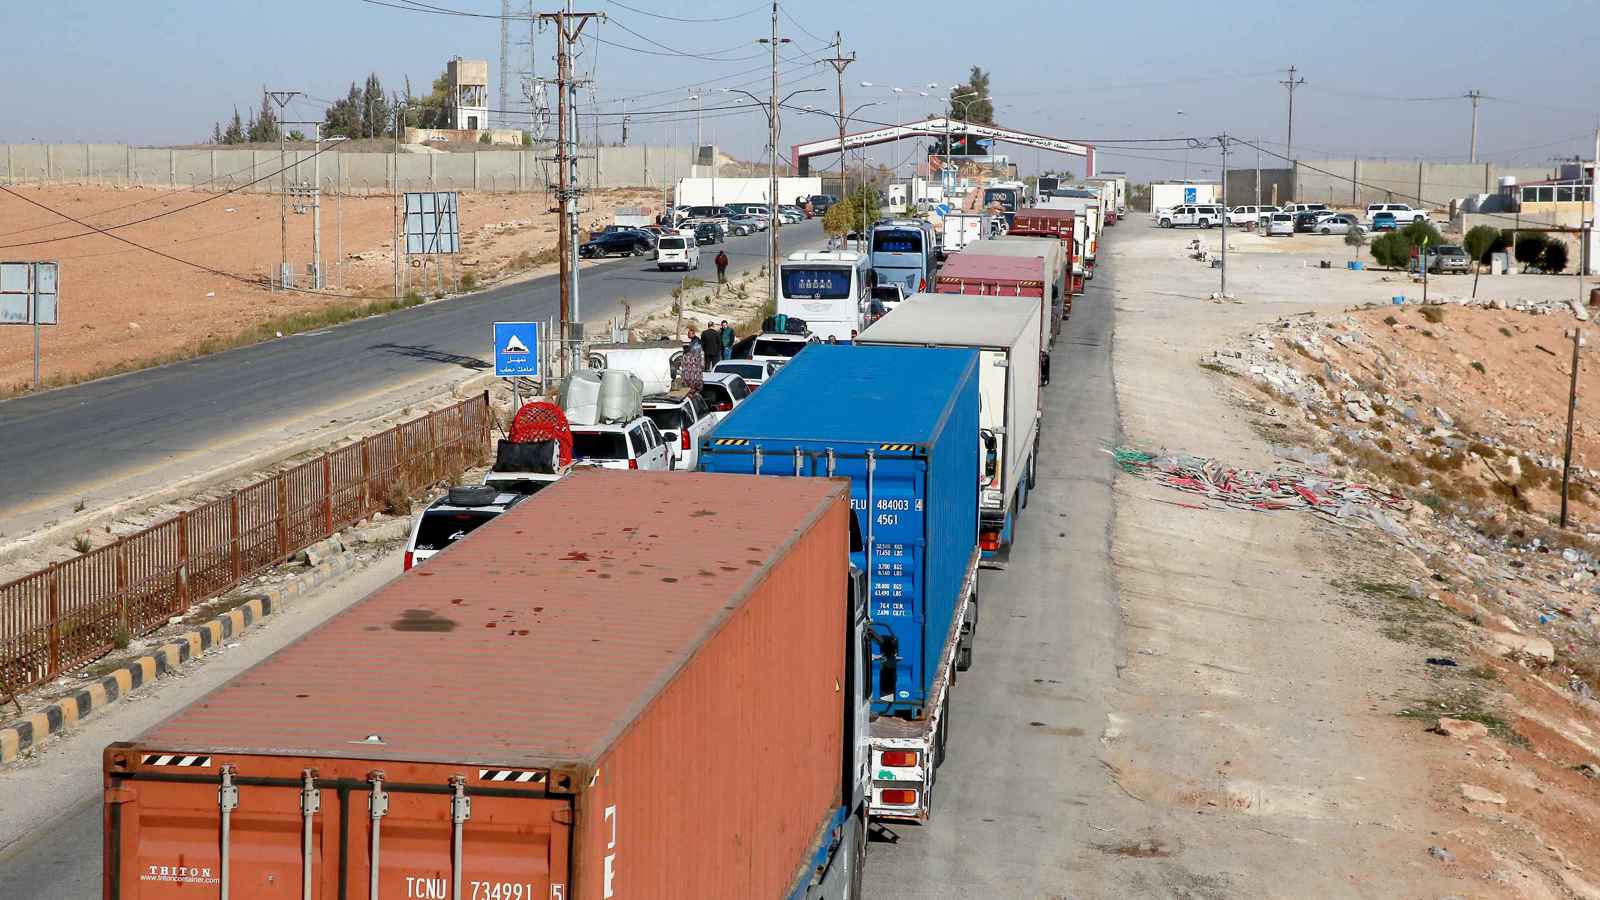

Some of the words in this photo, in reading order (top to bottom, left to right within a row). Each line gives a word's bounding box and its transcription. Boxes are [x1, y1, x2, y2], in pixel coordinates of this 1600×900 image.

[877, 499, 909, 511] 484003
[877, 514, 898, 525] 45G1
[149, 866, 211, 877] TRITON
[406, 877, 447, 899] TCNU
[471, 881, 531, 900] 734991
[552, 885, 563, 900] 5
